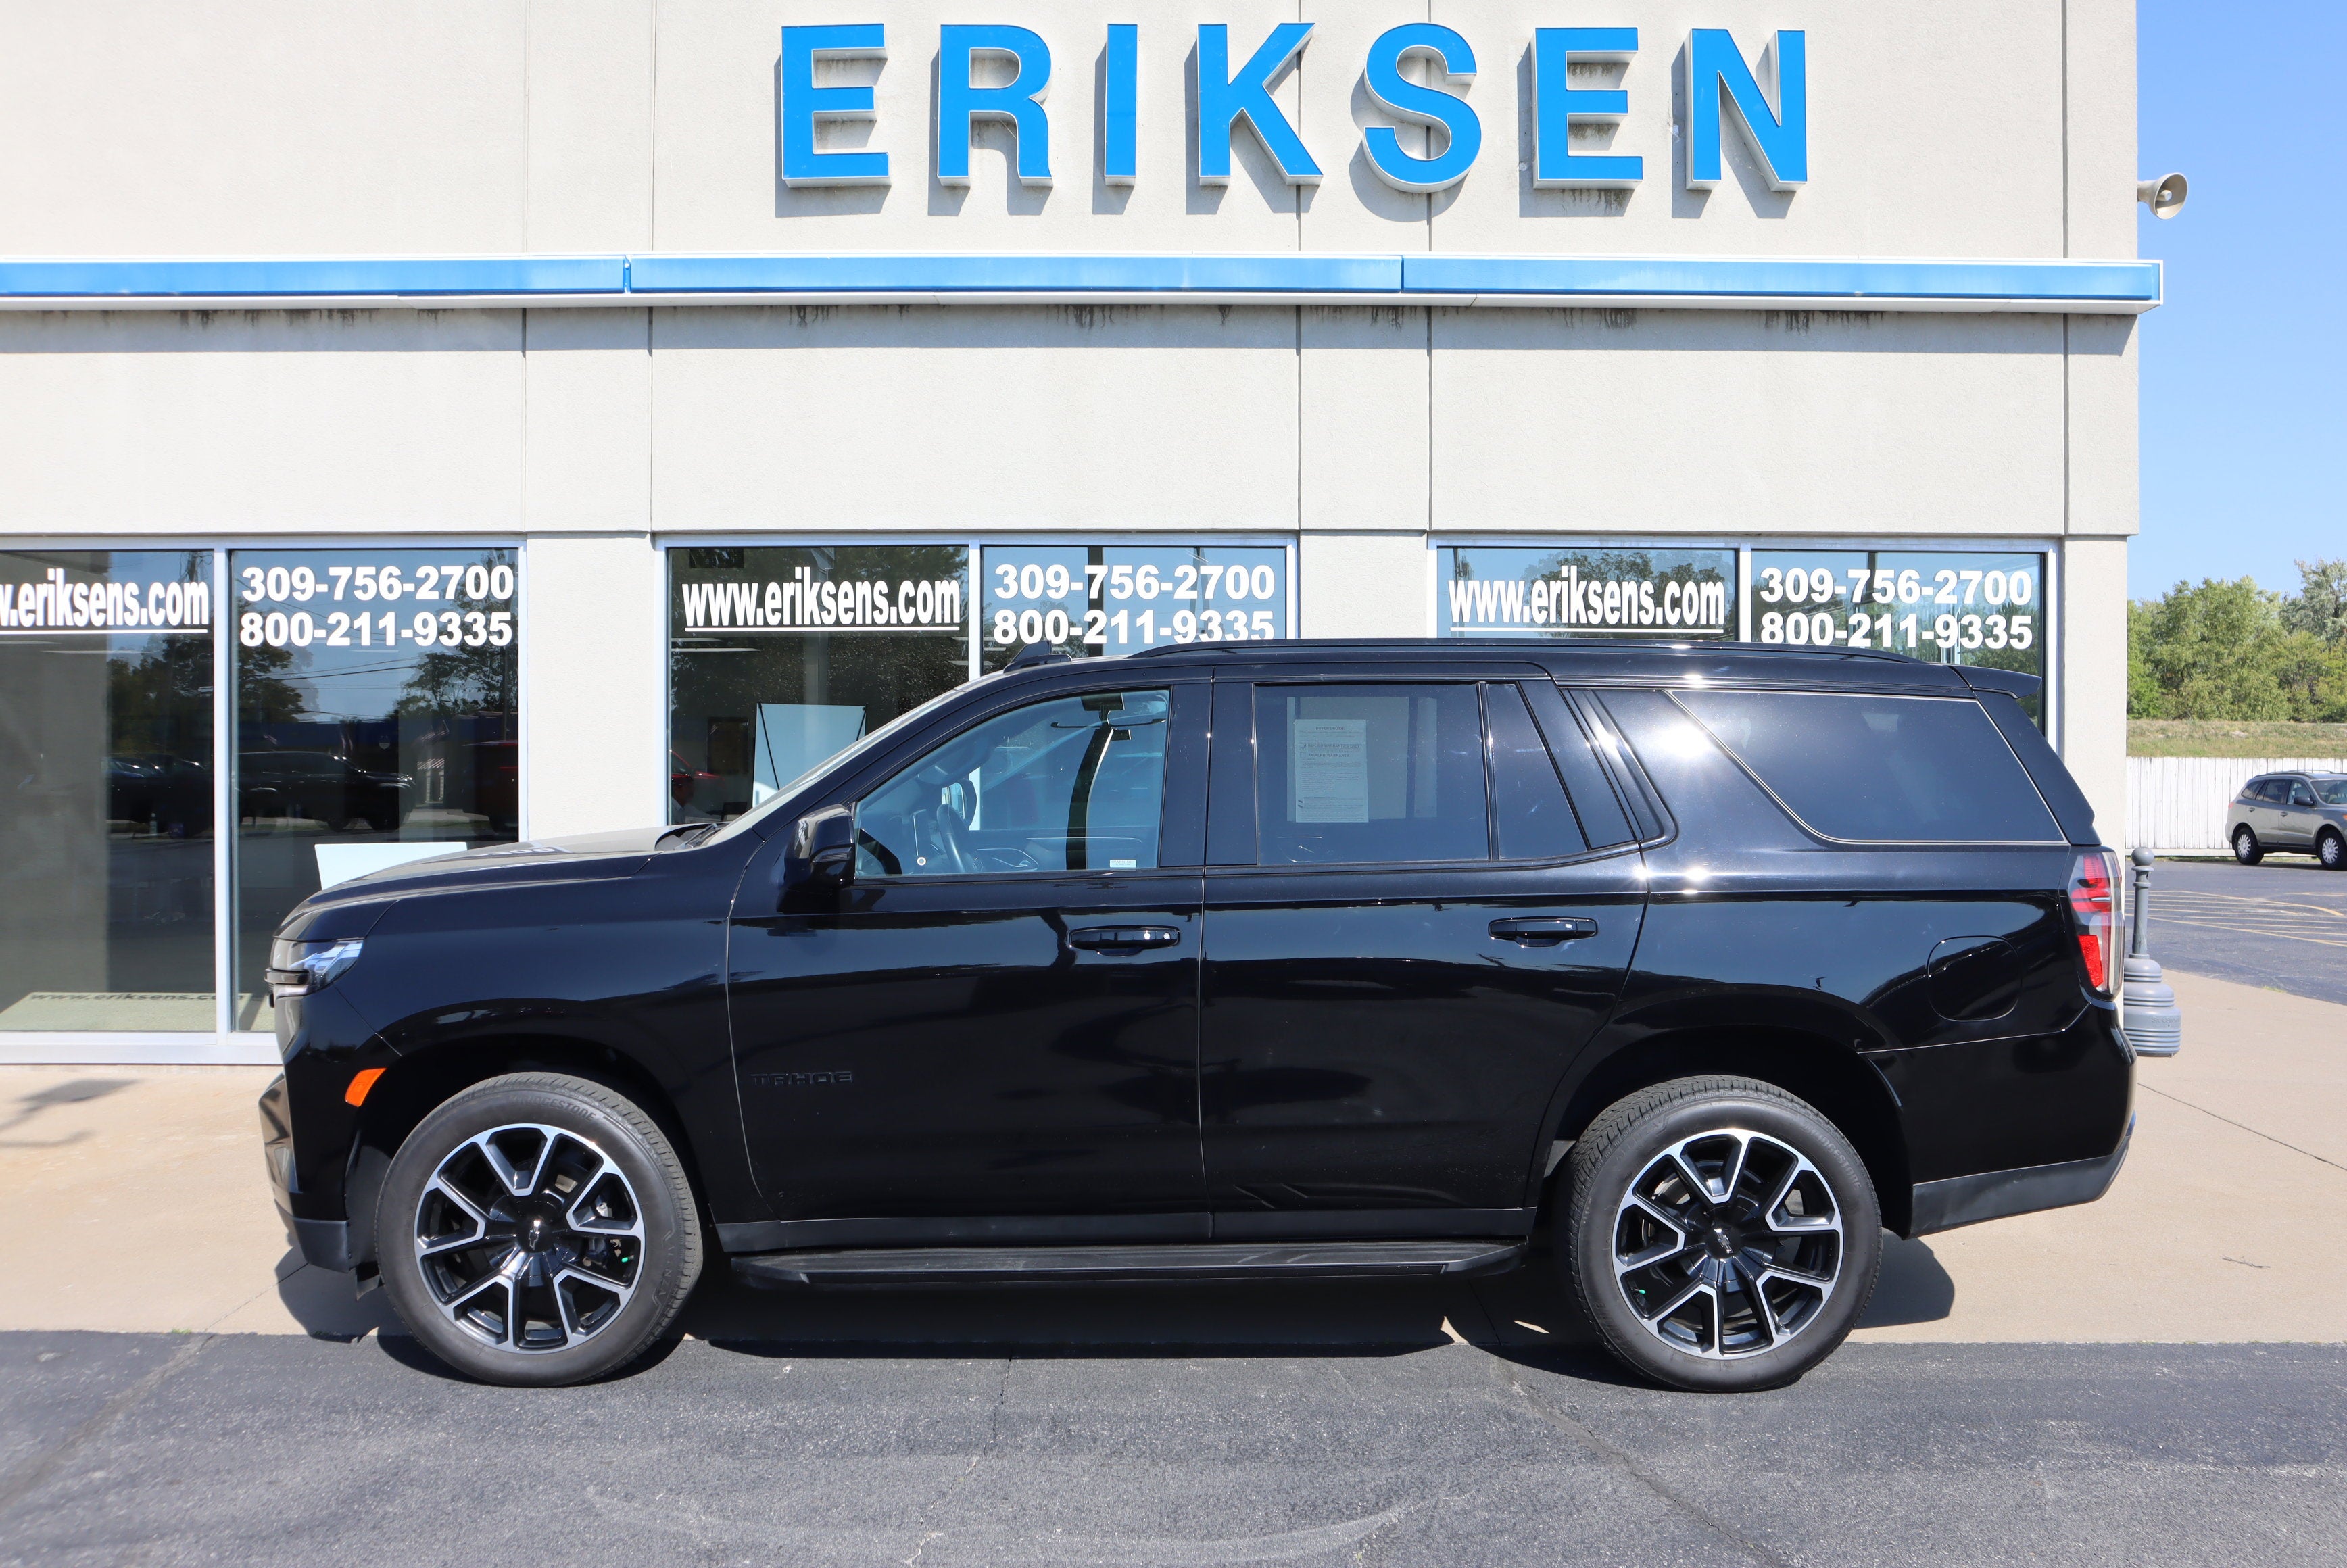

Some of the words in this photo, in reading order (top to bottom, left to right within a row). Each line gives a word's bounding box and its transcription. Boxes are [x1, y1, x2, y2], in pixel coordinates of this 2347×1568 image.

[781, 23, 1808, 189] ERIKSEN
[243, 566, 513, 601] 309-756-2700
[682, 567, 960, 626] www.eriksens.com
[995, 564, 1274, 599] 309-756-2700
[1448, 566, 1725, 625] www.eriksens.com
[1761, 568, 2033, 605] 309-756-2700
[241, 612, 512, 647] 800-211-9335
[994, 610, 1274, 644] 800-211-9335
[1762, 612, 2033, 649] 800-211-9335
[750, 1071, 853, 1086] TAHOE
